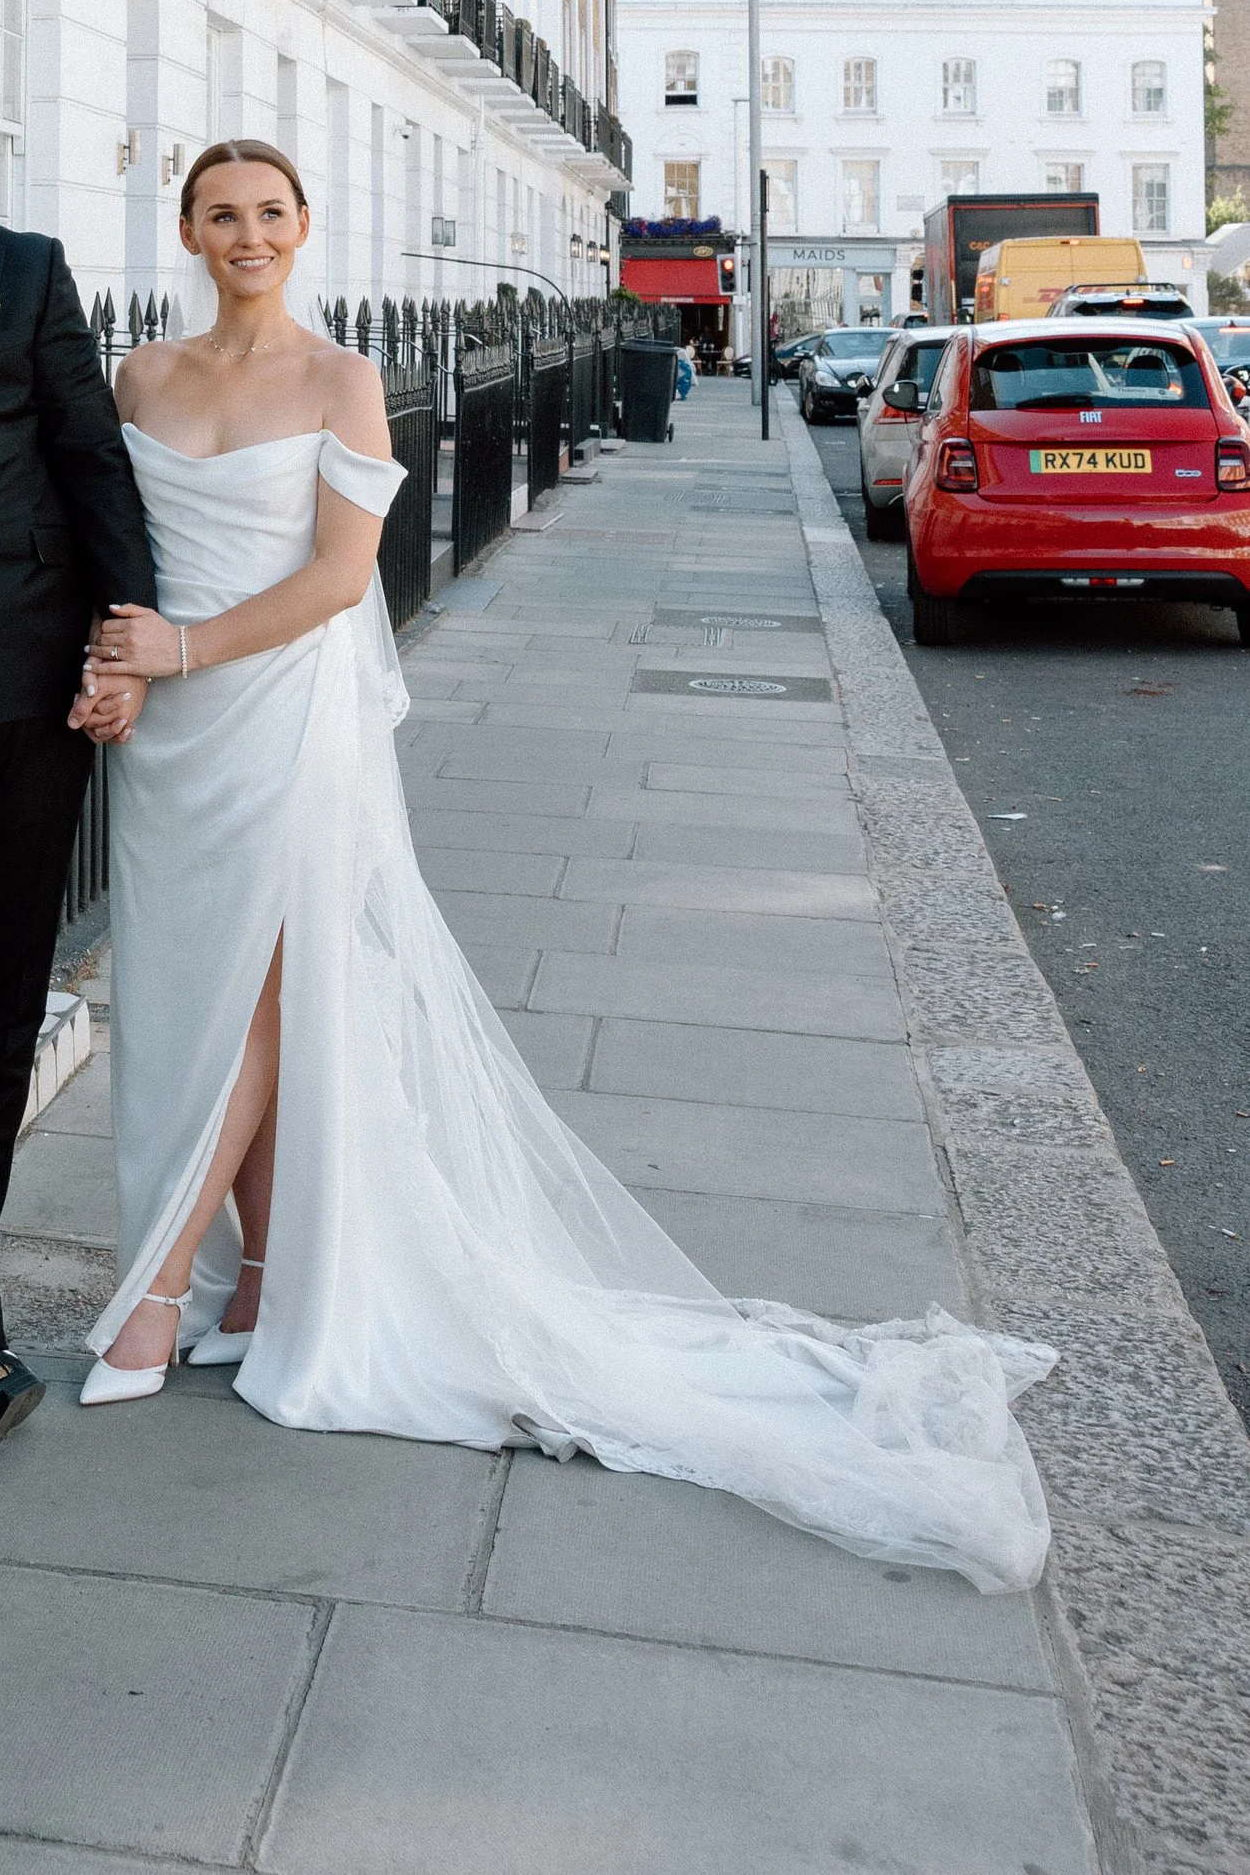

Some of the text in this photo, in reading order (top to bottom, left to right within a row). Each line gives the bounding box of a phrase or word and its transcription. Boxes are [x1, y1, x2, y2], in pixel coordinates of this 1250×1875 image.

[793, 249, 846, 261] MAIDS
[1079, 411, 1103, 423] FIAT
[1044, 452, 1146, 469] RX74 KUD
